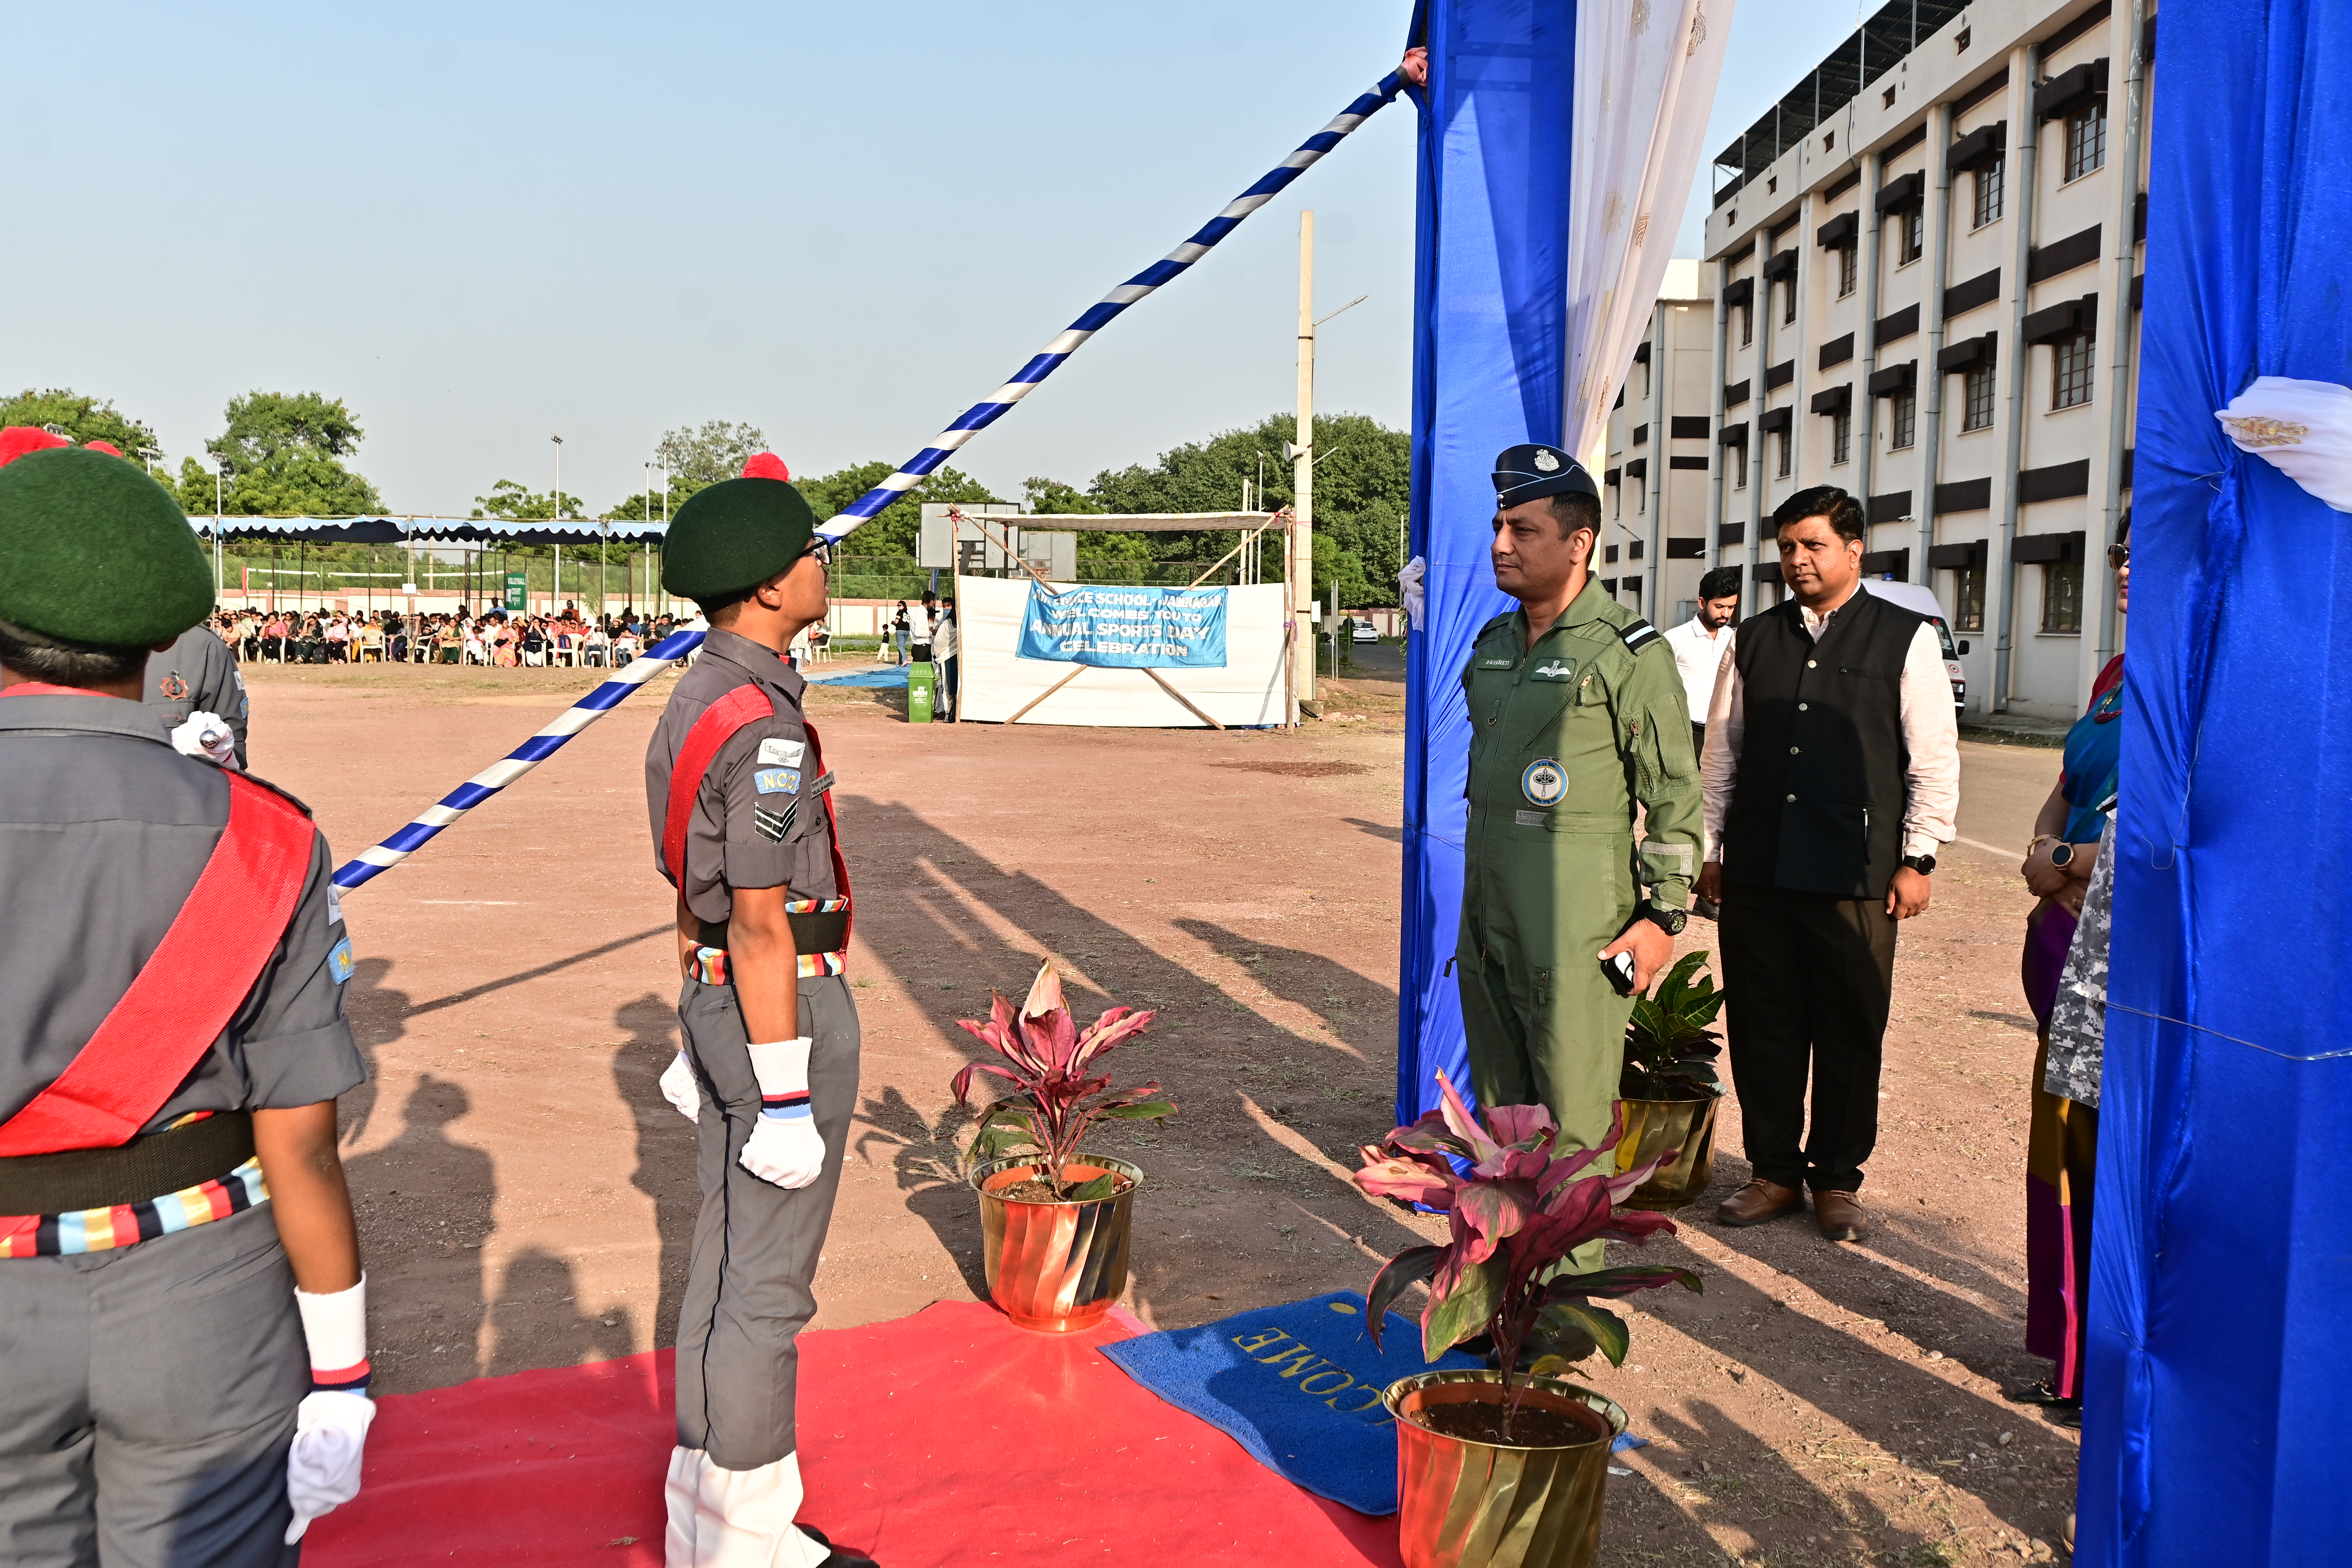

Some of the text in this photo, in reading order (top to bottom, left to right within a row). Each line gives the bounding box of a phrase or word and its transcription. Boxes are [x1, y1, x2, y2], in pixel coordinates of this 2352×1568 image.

[507, 577, 525, 585] VOLLEYBALL
[1096, 593, 1152, 606] SCHOOL
[1158, 595, 1222, 609] JAMNAGAR
[1153, 610, 1181, 621] YOU
[1182, 612, 1203, 622] TO
[1029, 619, 1211, 640] ANNUAL SPORTS DAY
[1060, 640, 1188, 656] CELEBRATION
